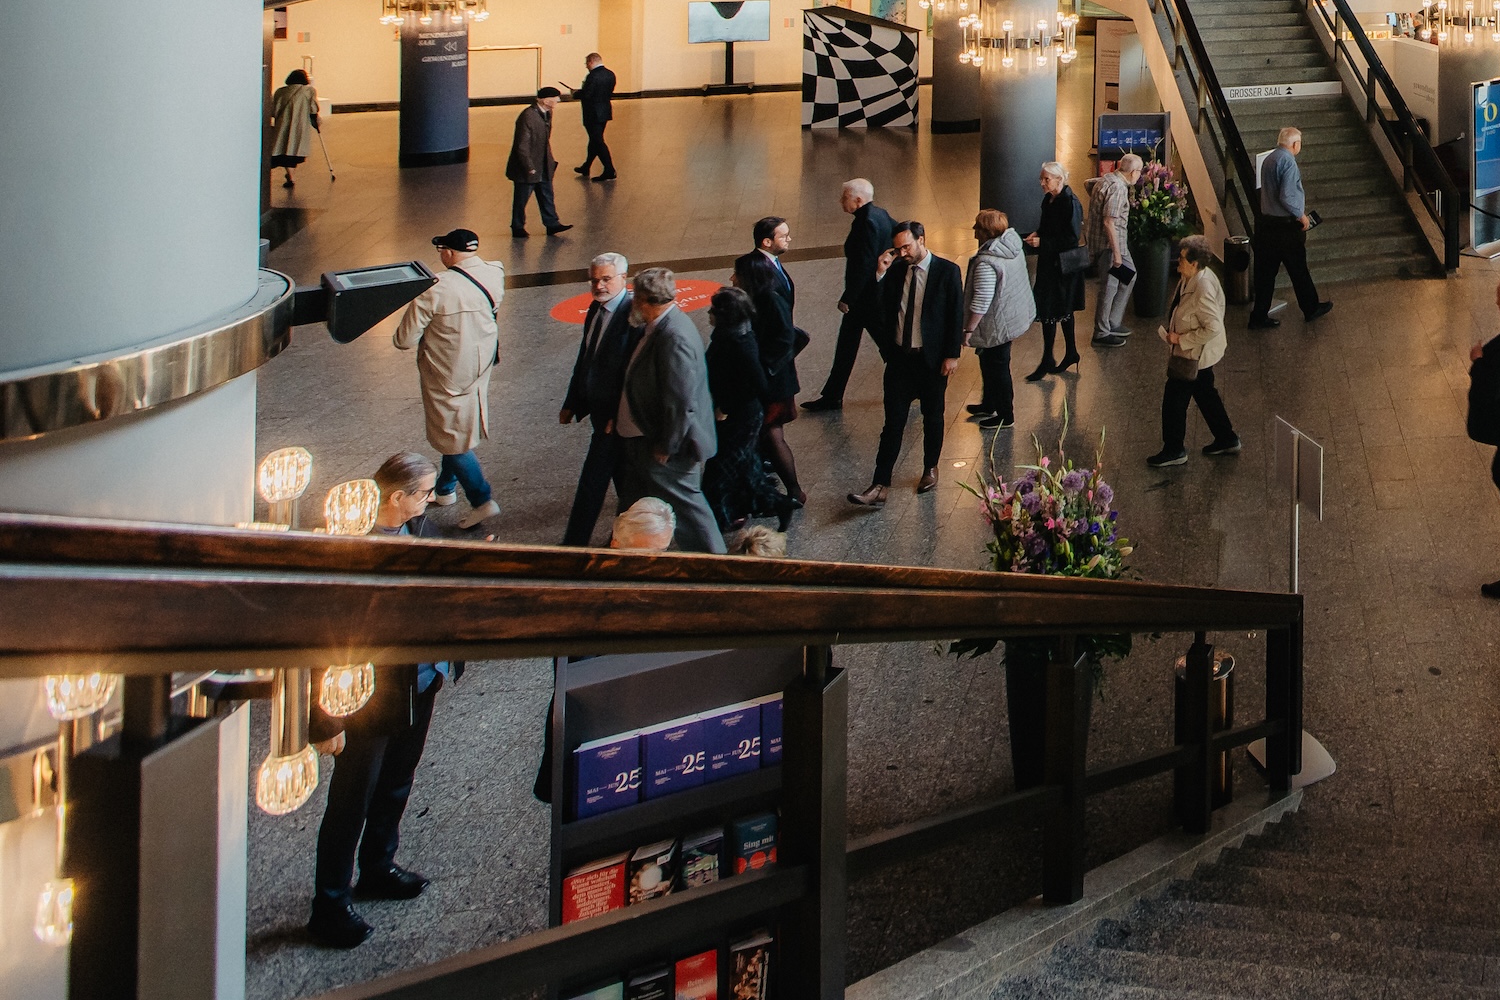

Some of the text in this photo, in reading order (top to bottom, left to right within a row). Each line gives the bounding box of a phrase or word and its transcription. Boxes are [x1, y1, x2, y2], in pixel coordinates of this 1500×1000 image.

[1229, 86, 1282, 99] GROSSER SAAL
[738, 736, 761, 760] 25
[682, 751, 705, 775] 25
[615, 767, 642, 793] 25
[743, 839, 760, 851] Sing
